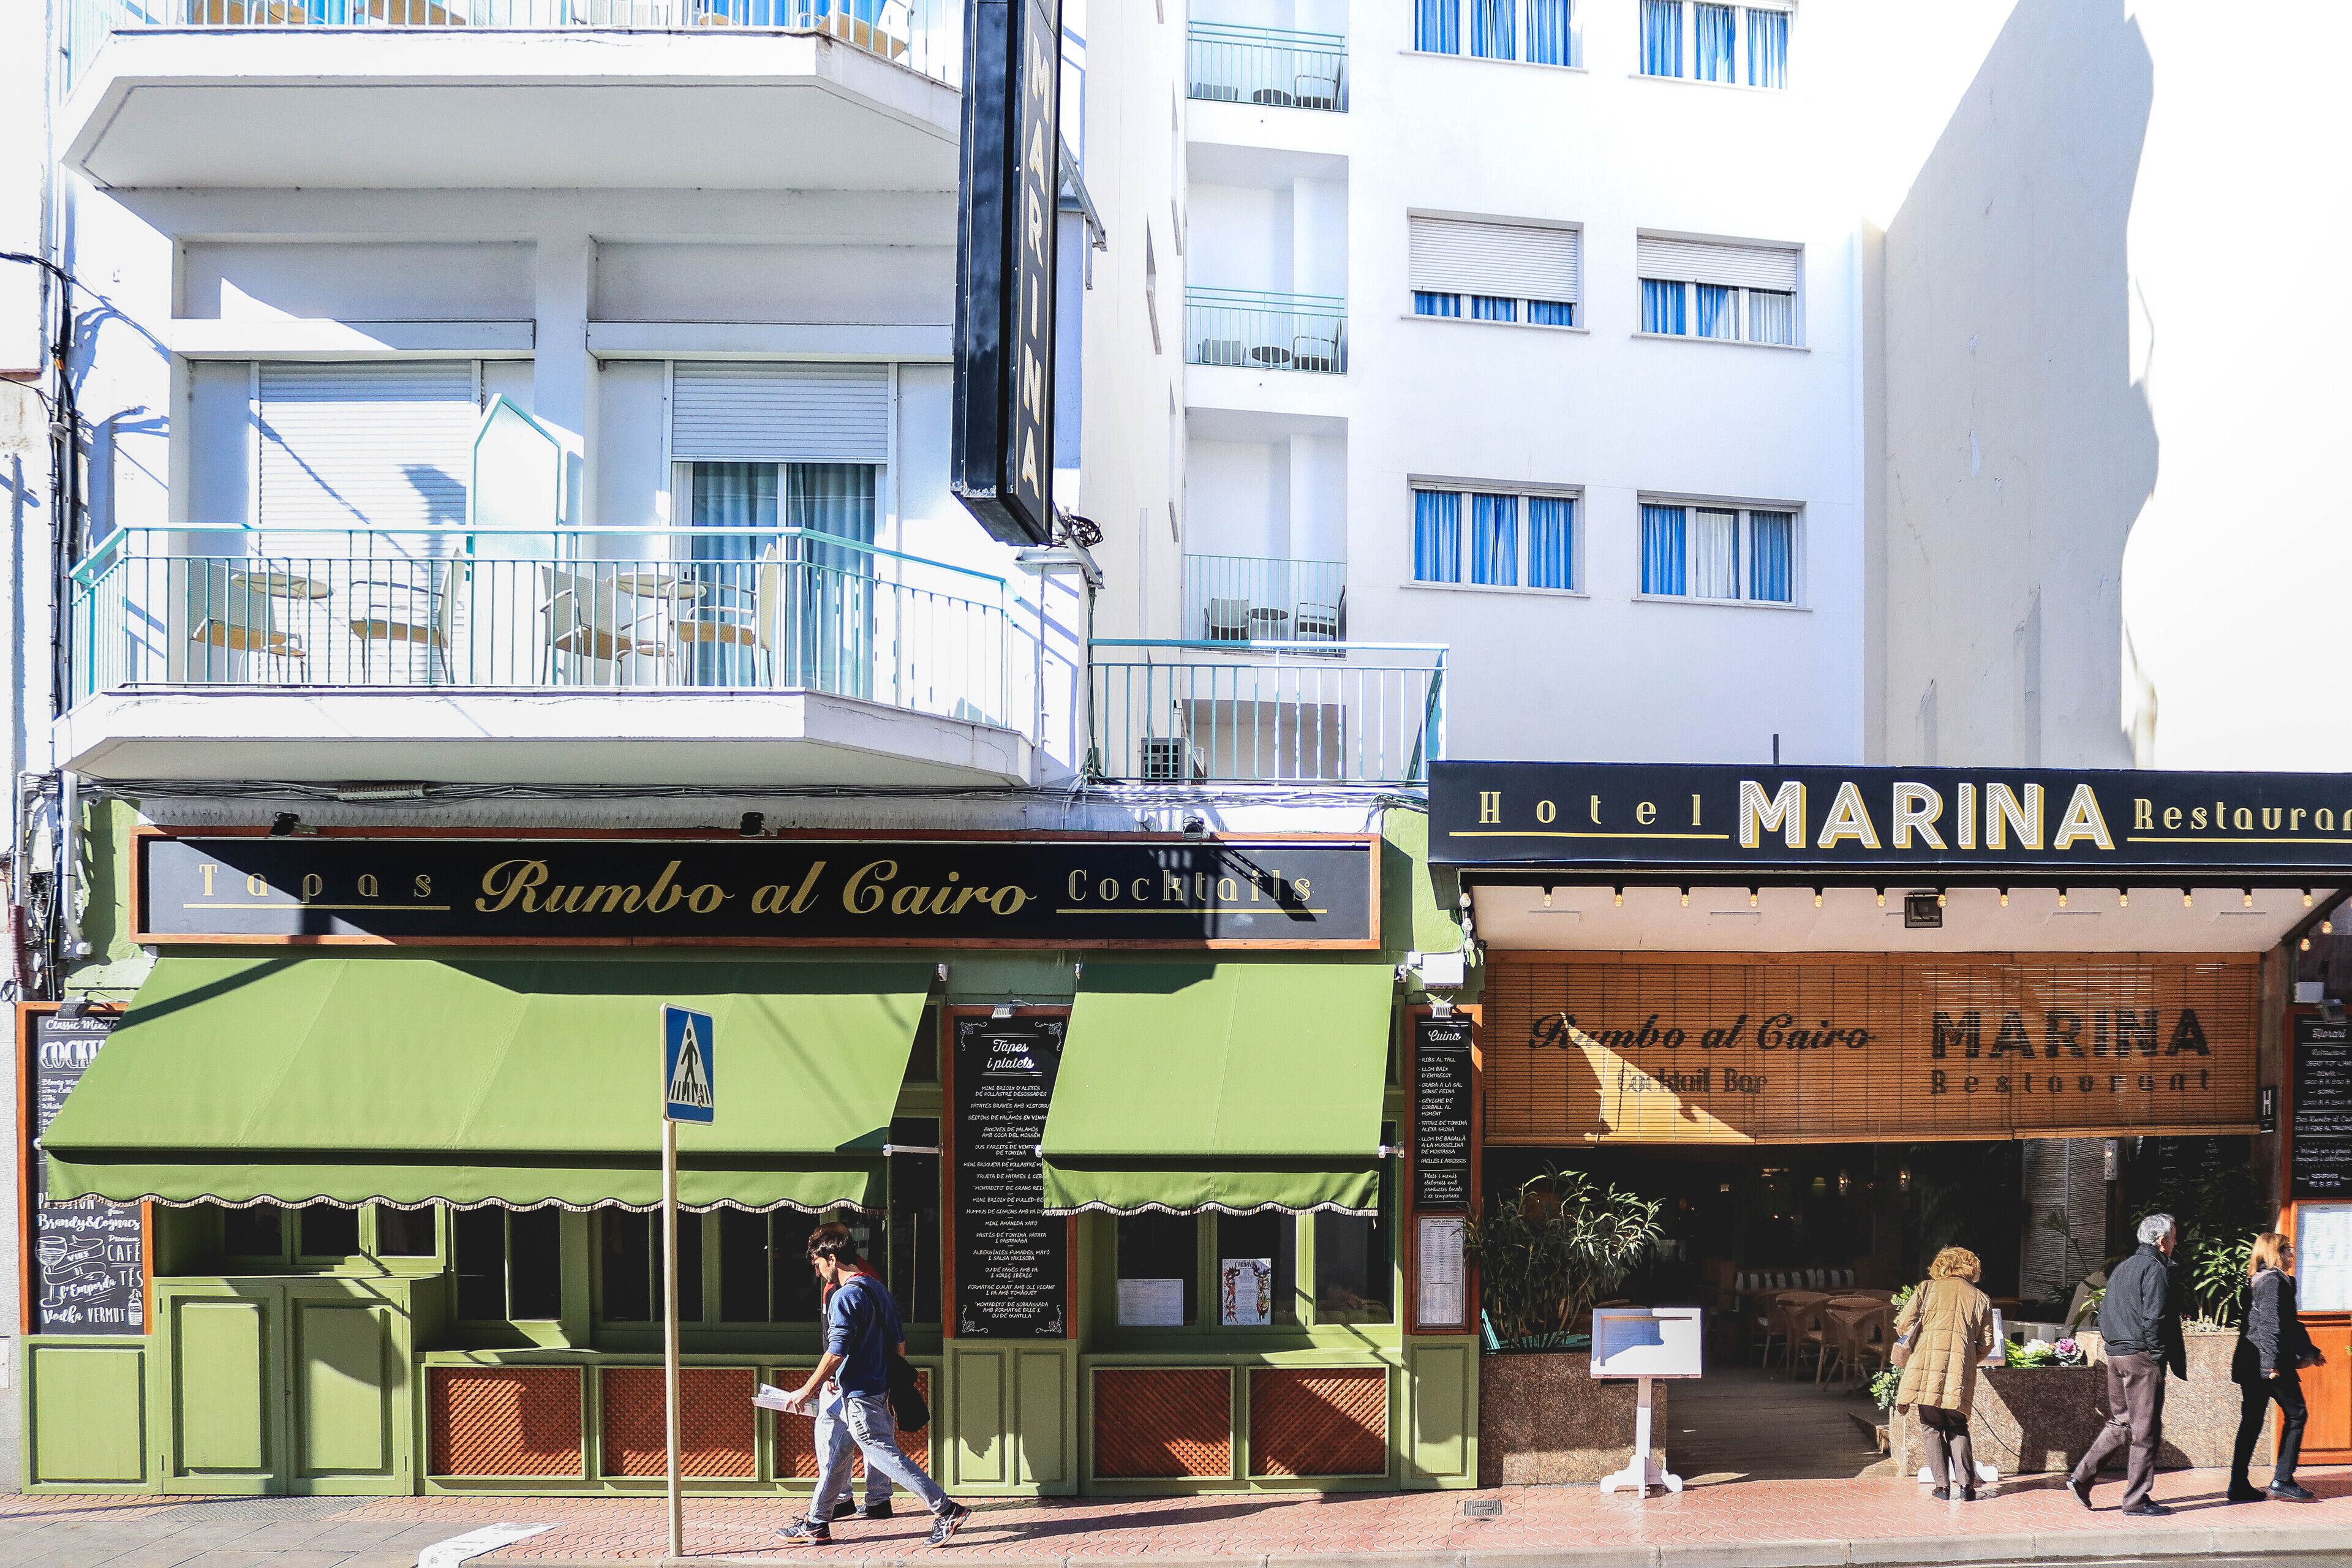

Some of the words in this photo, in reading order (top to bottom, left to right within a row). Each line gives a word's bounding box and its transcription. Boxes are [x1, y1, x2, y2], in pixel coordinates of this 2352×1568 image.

[1022, 32, 1050, 499] MARINA
[1479, 791, 1702, 826] Hotel
[1740, 780, 2115, 850] MARINA
[198, 864, 431, 903] Tapas
[475, 859, 735, 914] Rumbo
[751, 860, 827, 914] al
[842, 859, 1038, 915] Cairo
[1068, 869, 1311, 902] Cocktails
[1428, 1030, 1461, 1041] Cuina
[1531, 1014, 1691, 1049] Rumbo
[1700, 1015, 1749, 1049] al
[1757, 1014, 1877, 1050] Cairo
[1931, 1009, 2212, 1058] MARINA
[993, 1039, 1029, 1054] Tapes
[987, 1058, 992, 1068] i
[992, 1057, 1035, 1071] platets
[1617, 1068, 1710, 1093] Cocktail
[1724, 1068, 1767, 1093] Bar
[1931, 1069, 2209, 1095] Restaurant
[2263, 1090, 2271, 1115] H
[67, 1251, 89, 1261] VINS
[108, 1243, 140, 1262] CAFÉ
[74, 1267, 84, 1276] DE
[119, 1268, 143, 1287] TÉS
[42, 1305, 84, 1324] Vodka
[88, 1308, 126, 1323] VERMUT
